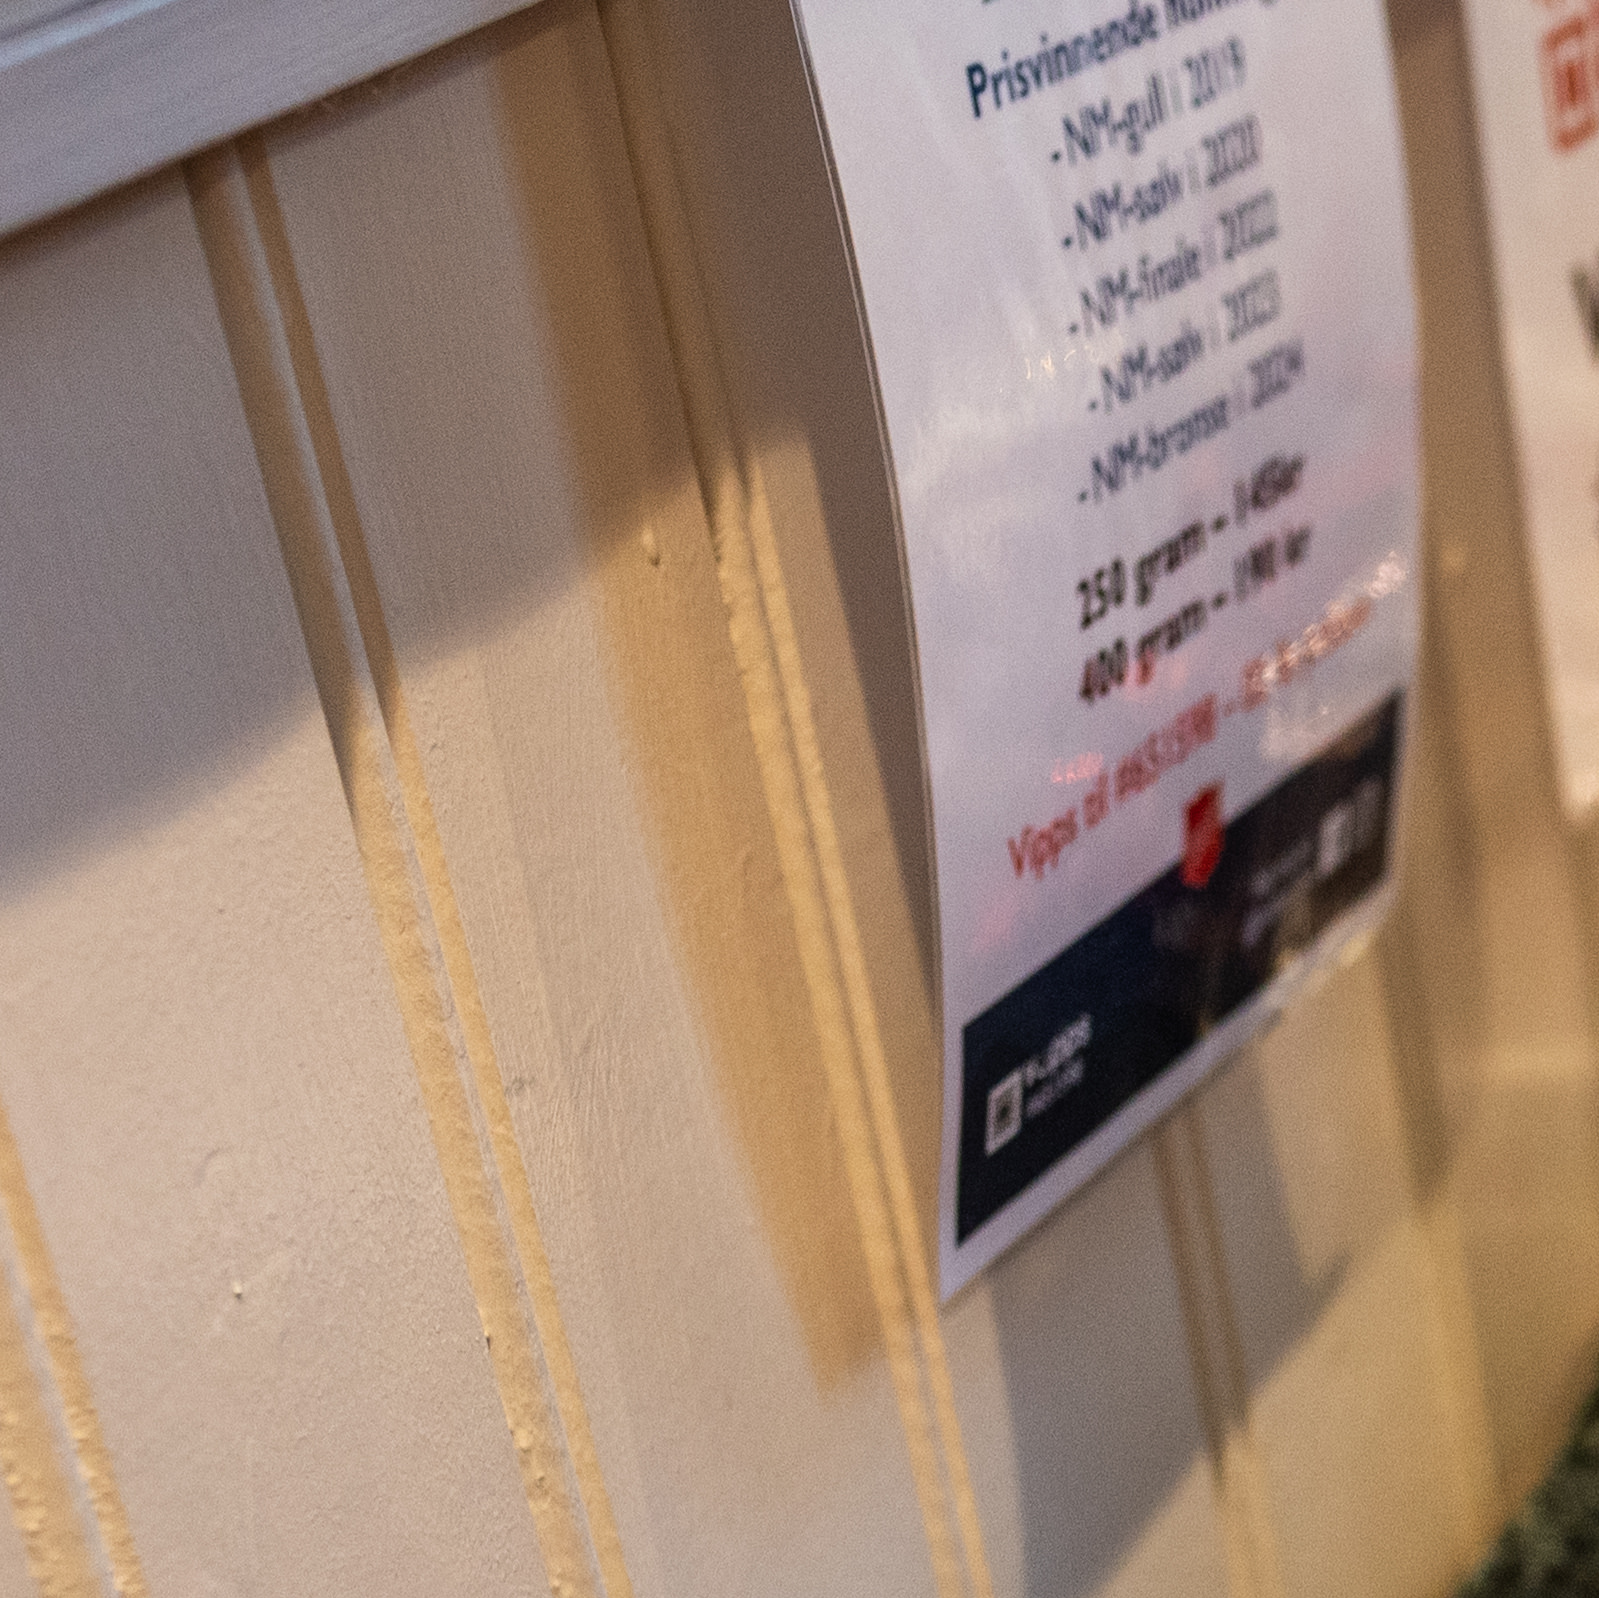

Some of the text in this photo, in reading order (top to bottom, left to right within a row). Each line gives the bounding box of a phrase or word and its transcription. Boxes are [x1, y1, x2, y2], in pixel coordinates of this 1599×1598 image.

[966, 0, 1159, 119] Prisvinnende
[1078, 557, 1127, 631] 250
[1134, 519, 1207, 609] gram
[1079, 637, 1129, 704] 400
[1135, 599, 1207, 685] gram
[1007, 808, 1078, 881] Vipps
